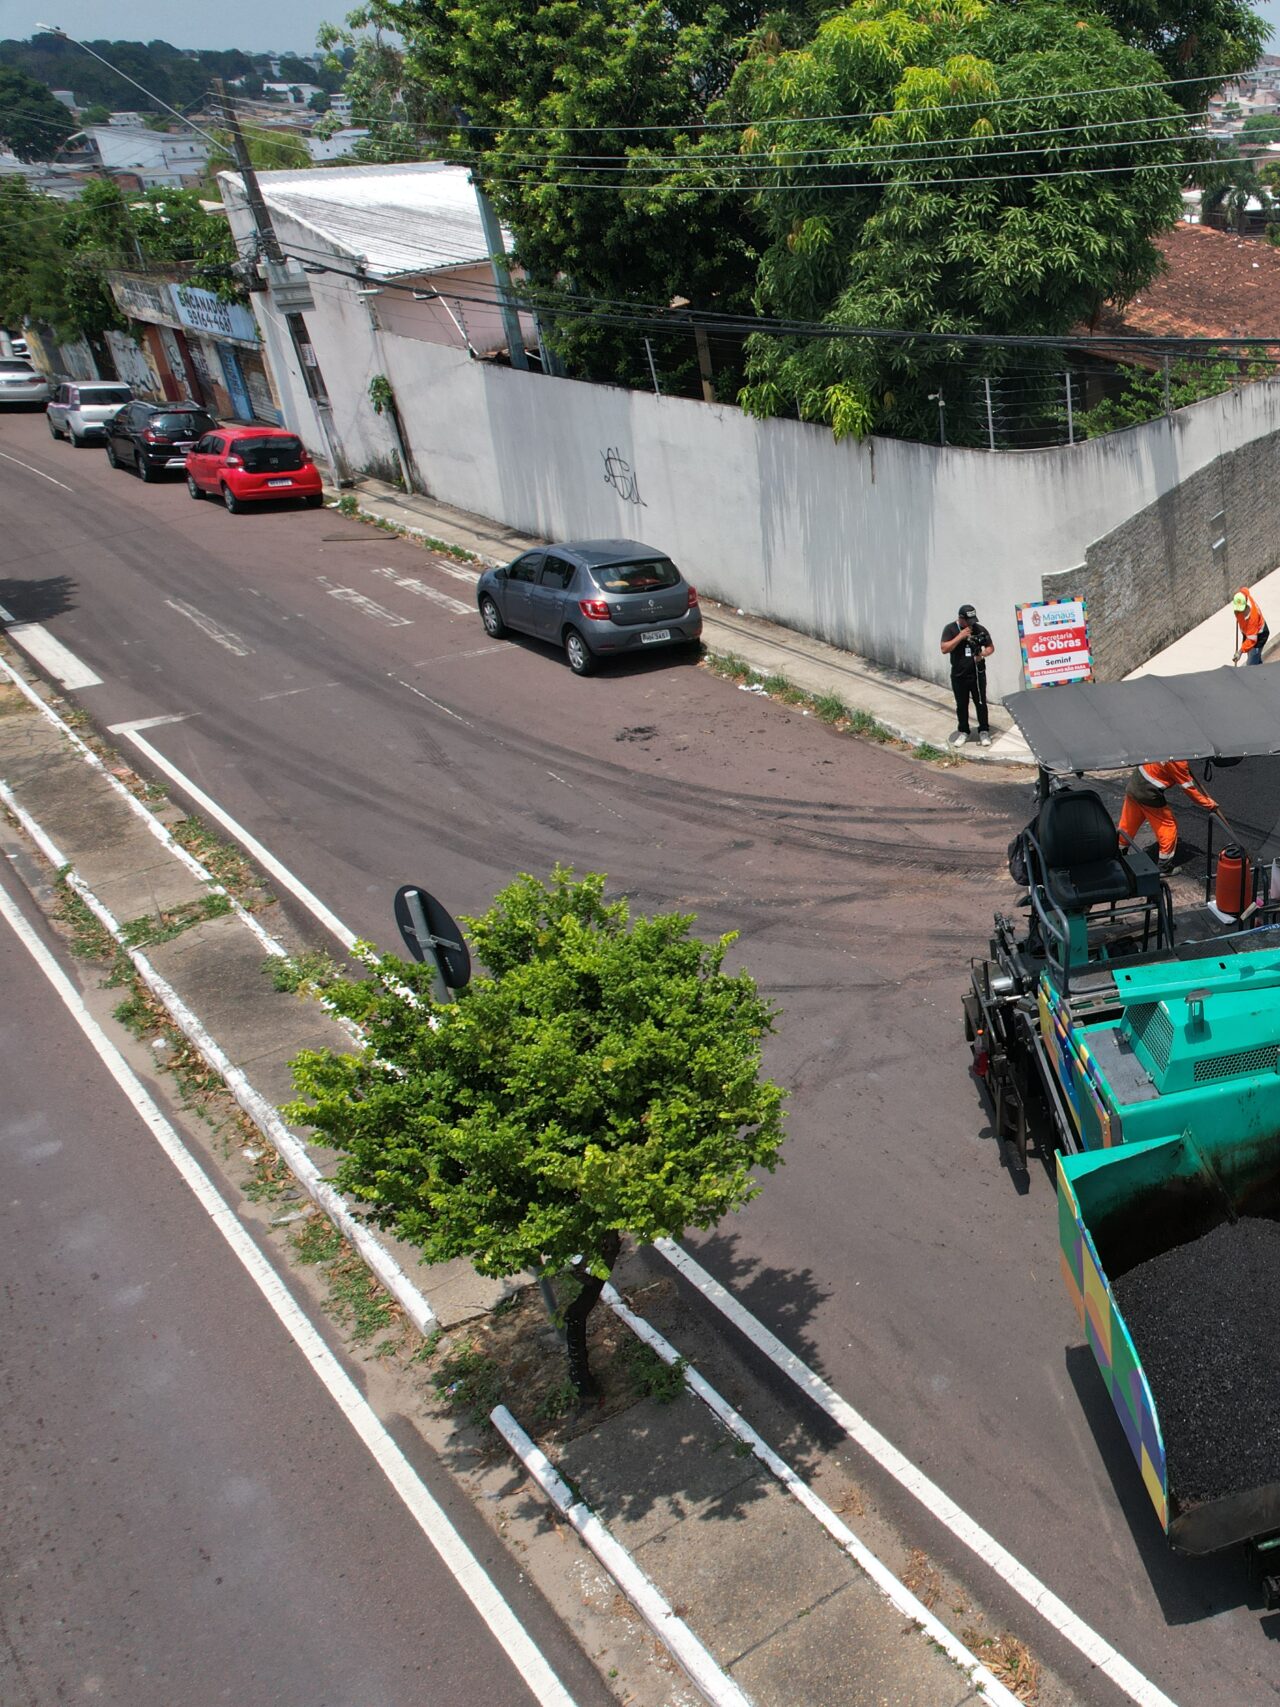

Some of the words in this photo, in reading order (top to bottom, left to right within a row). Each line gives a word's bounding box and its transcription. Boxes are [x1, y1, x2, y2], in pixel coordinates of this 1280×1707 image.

[177, 291, 229, 316] ENCANADOR
[1043, 611, 1075, 621] Manaus
[1039, 632, 1073, 642] Secretaria
[1032, 643, 1046, 653] de
[1048, 638, 1082, 650] Obras
